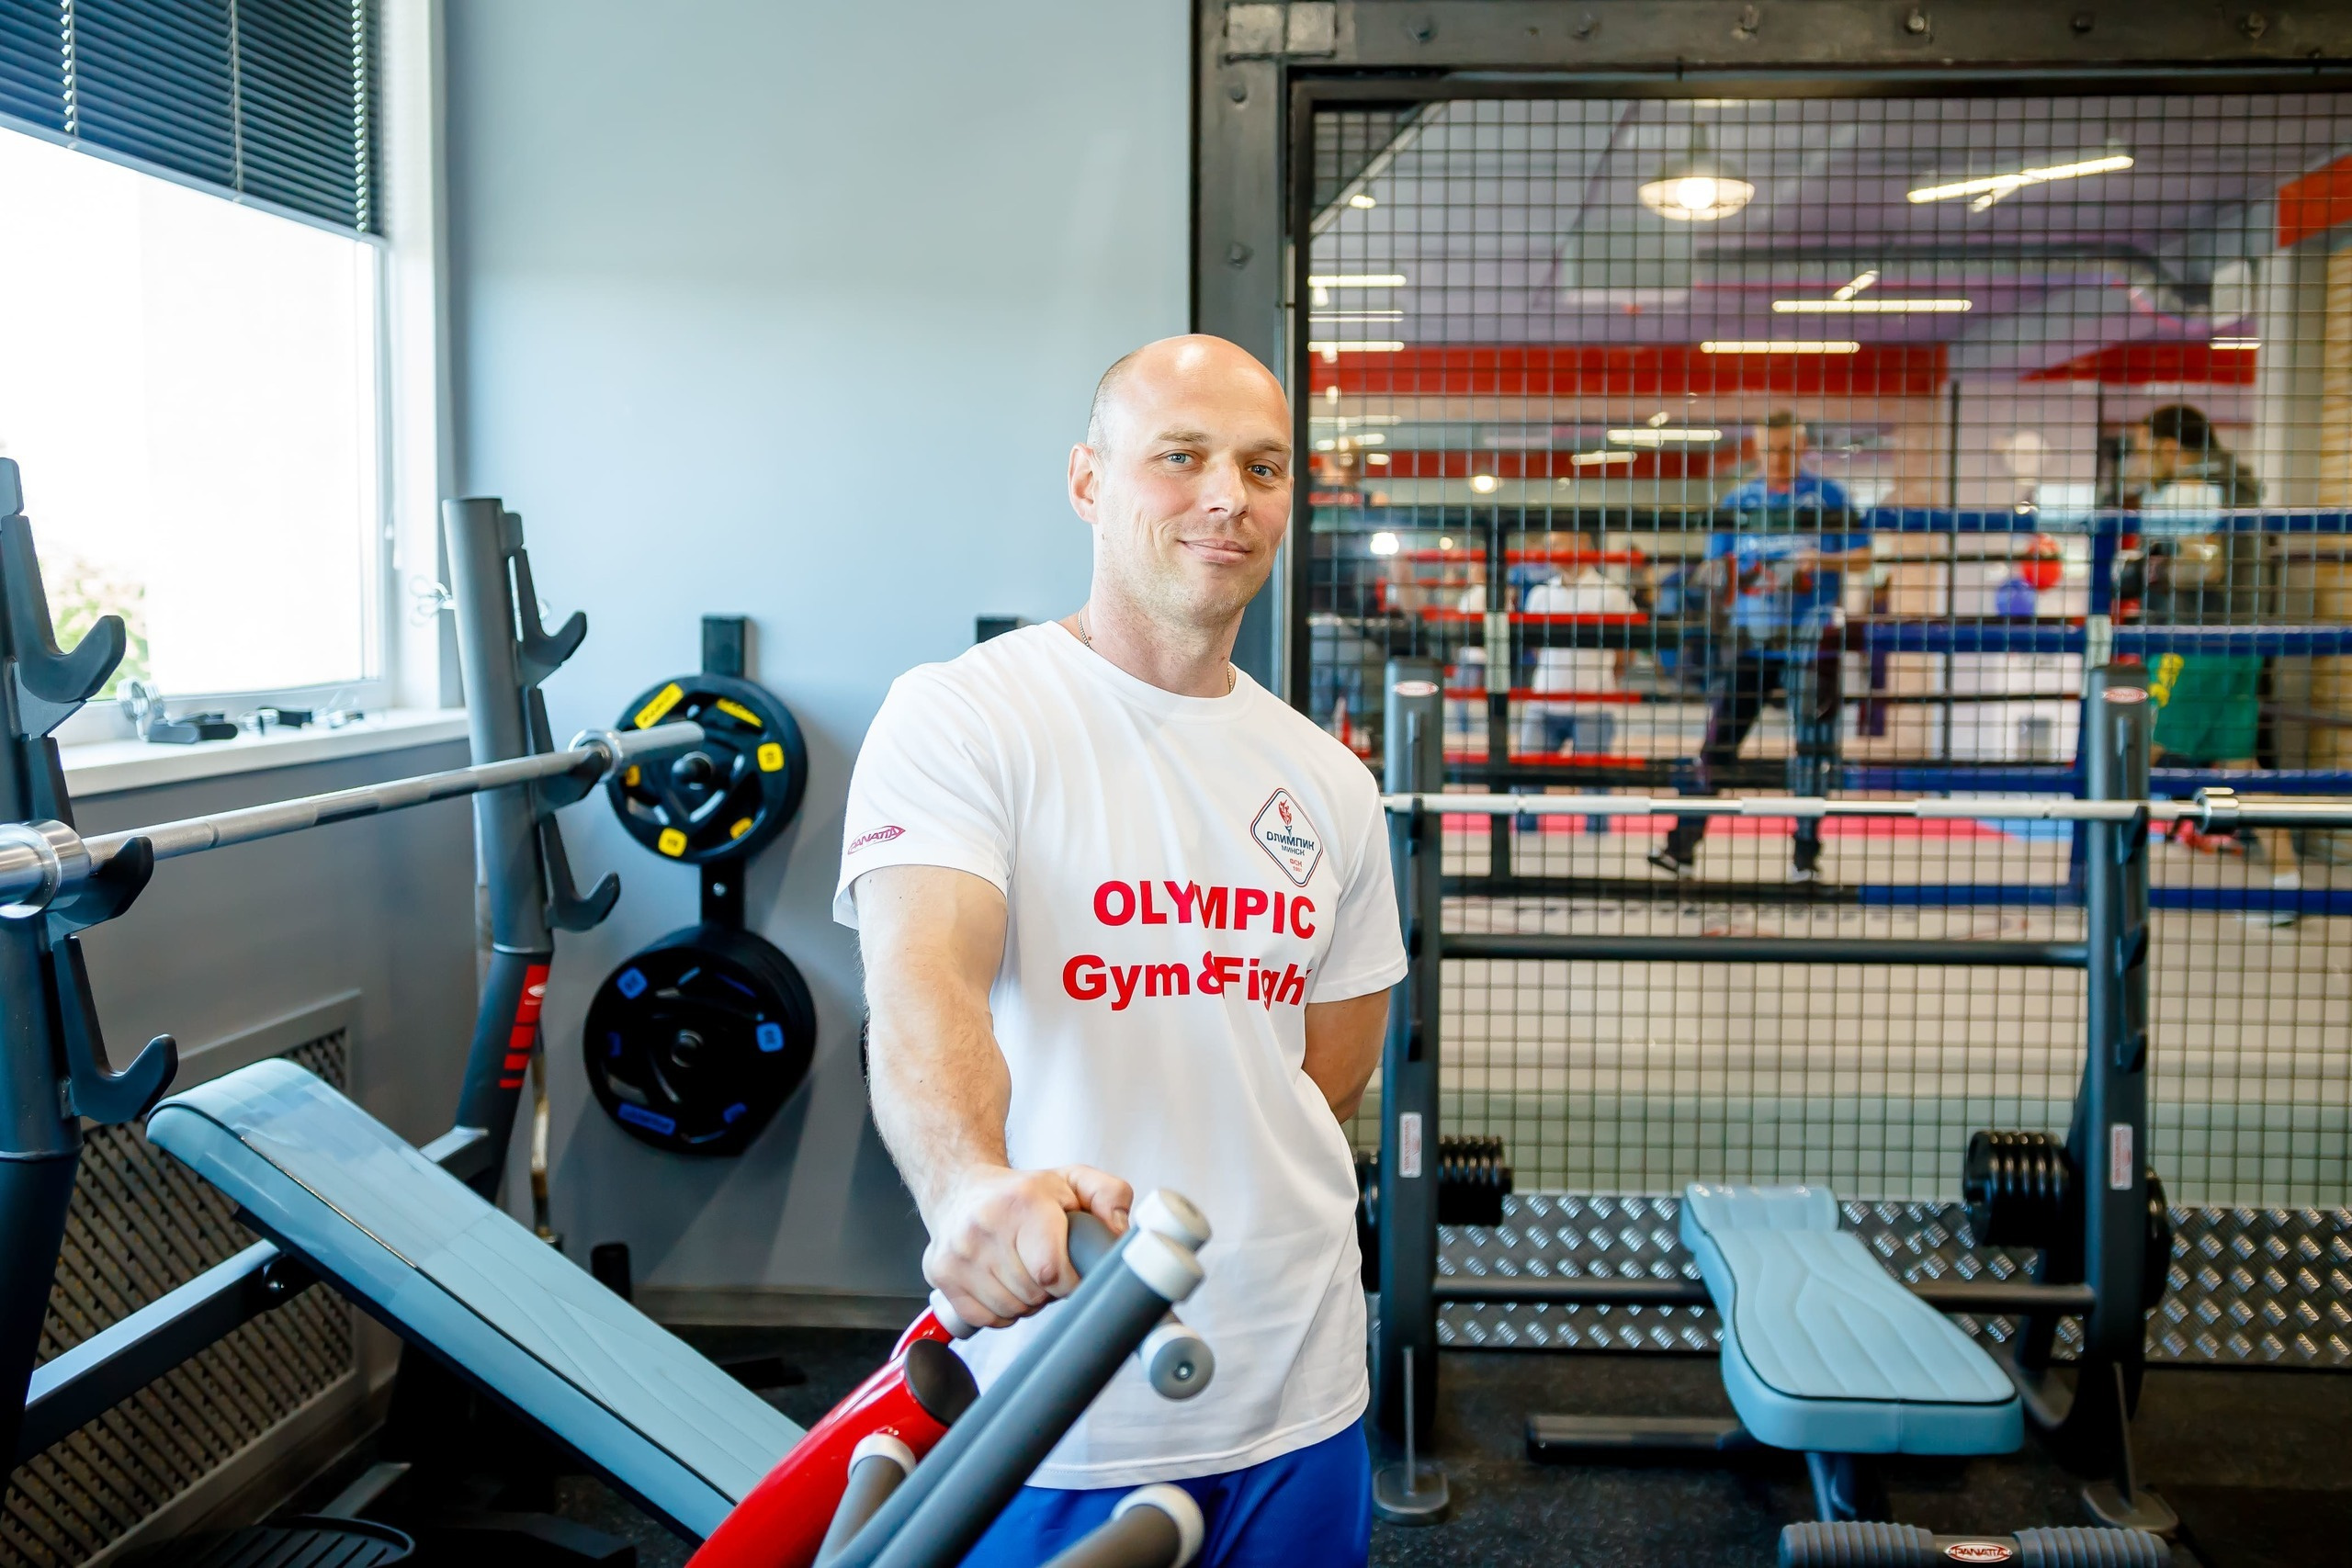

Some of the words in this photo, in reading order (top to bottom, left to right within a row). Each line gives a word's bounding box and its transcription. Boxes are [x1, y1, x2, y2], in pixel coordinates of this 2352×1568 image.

[1266, 831, 1315, 851] ОЛИМПИК
[1281, 844, 1305, 856] МИНСК
[1093, 880, 1317, 940] OLYMPIC
[1954, 1547, 2006, 1557] PANATTA
